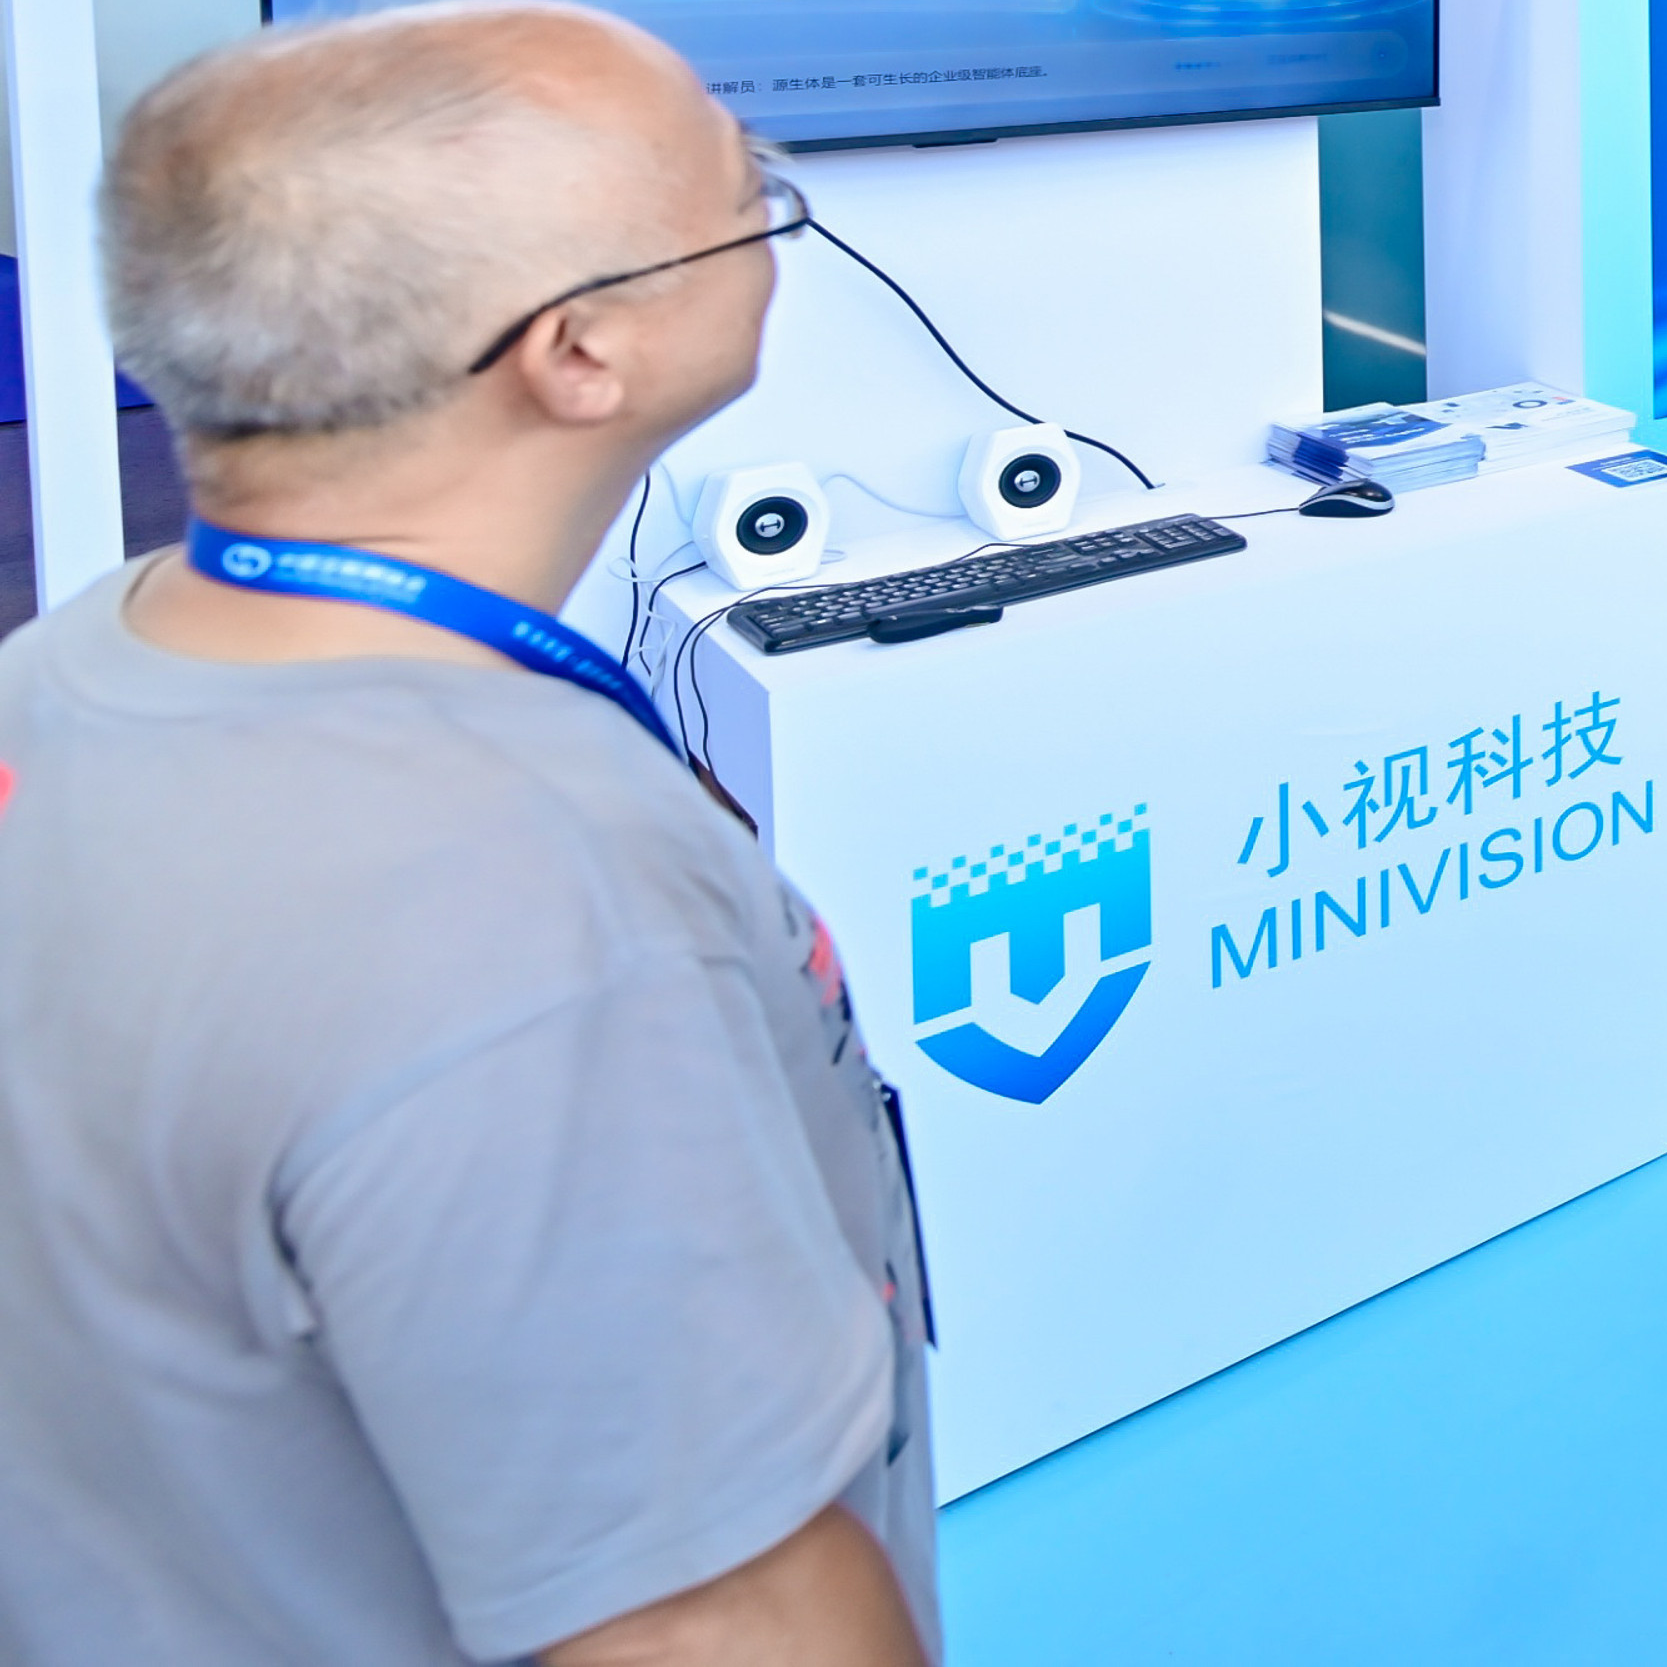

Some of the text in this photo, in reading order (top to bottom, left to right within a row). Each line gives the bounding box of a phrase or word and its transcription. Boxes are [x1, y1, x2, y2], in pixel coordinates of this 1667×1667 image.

[1236, 690, 1626, 879] 小视科技
[1211, 780, 1655, 990] MINIVISION
